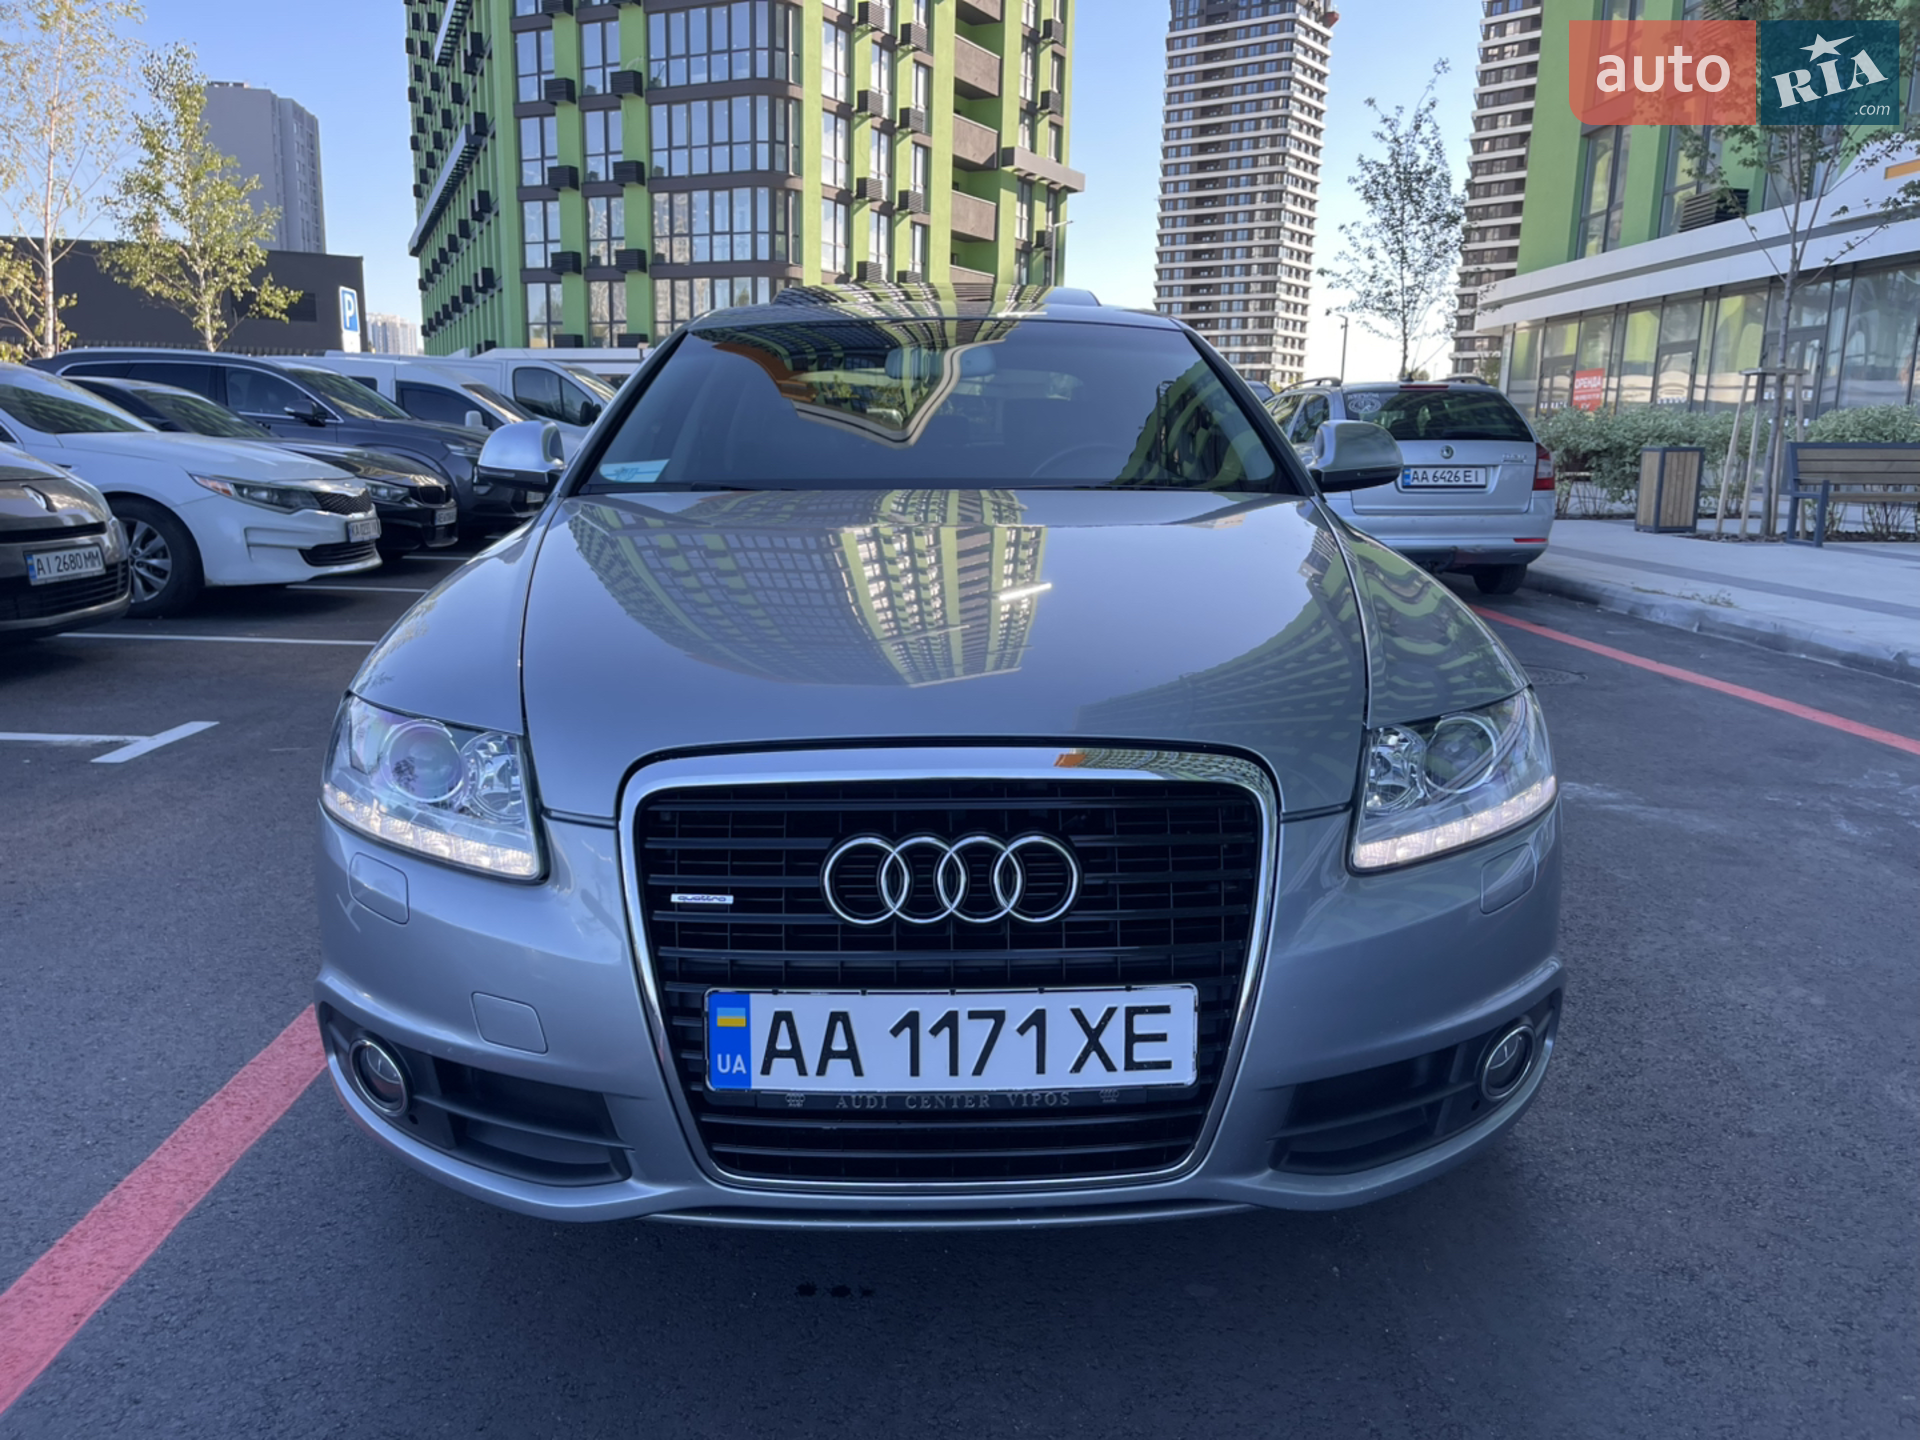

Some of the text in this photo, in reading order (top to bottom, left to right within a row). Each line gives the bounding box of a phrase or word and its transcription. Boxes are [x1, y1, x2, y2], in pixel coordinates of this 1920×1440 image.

[344, 292, 355, 329] P
[1411, 469, 1479, 483] AA 6426 EI
[36, 549, 102, 576] AI 2680 MM
[677, 894, 727, 903] quattro
[759, 1004, 1173, 1077] AA 1171 XE
[716, 1054, 747, 1075] UA
[836, 1090, 1071, 1109] AUDI CENTER VIPOS
